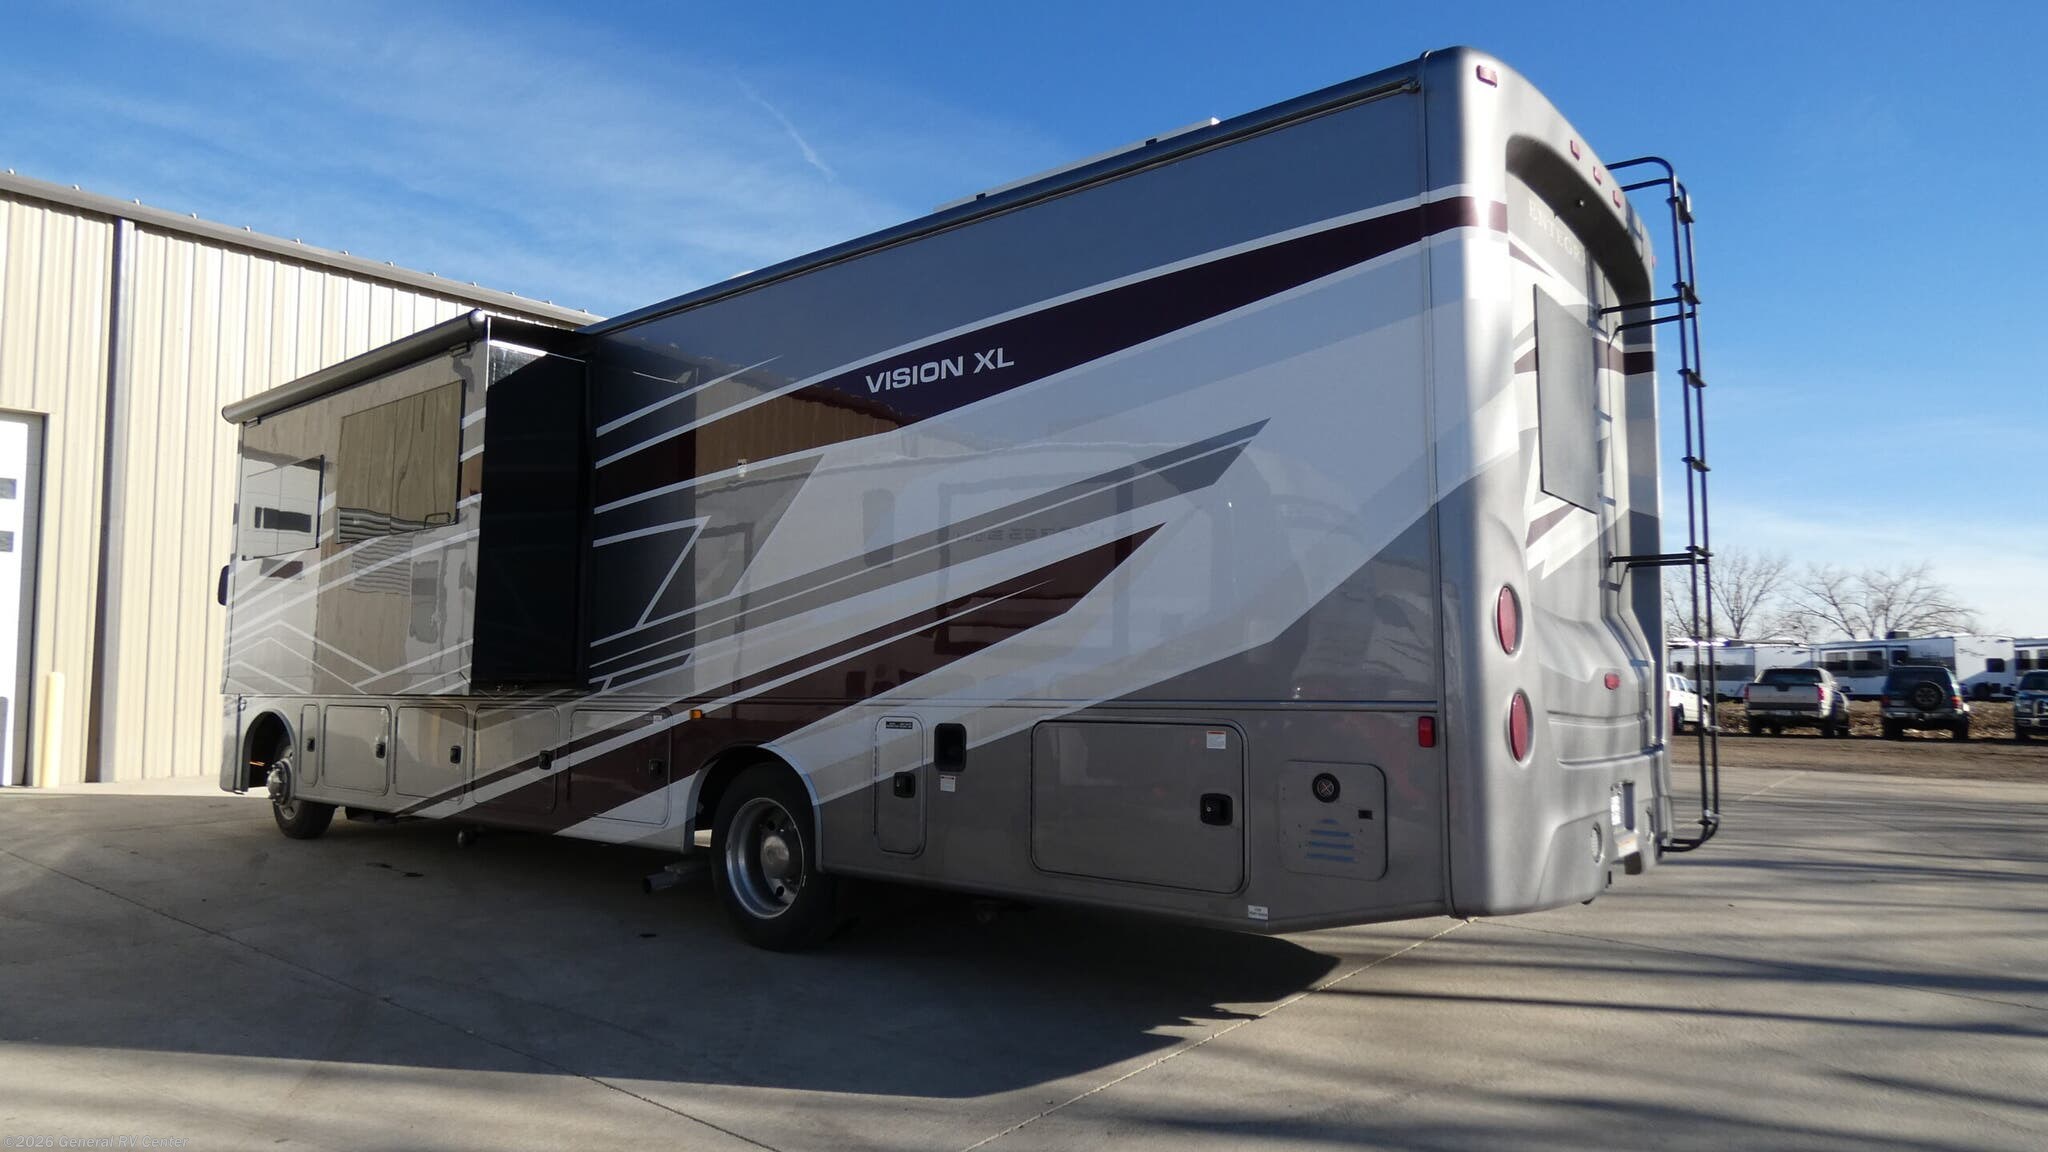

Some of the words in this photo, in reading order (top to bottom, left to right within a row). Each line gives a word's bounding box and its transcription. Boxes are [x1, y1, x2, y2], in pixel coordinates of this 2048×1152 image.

[1527, 198, 1585, 266] ENTEGR
[865, 356, 964, 394] VISION
[973, 347, 1015, 374] XL
